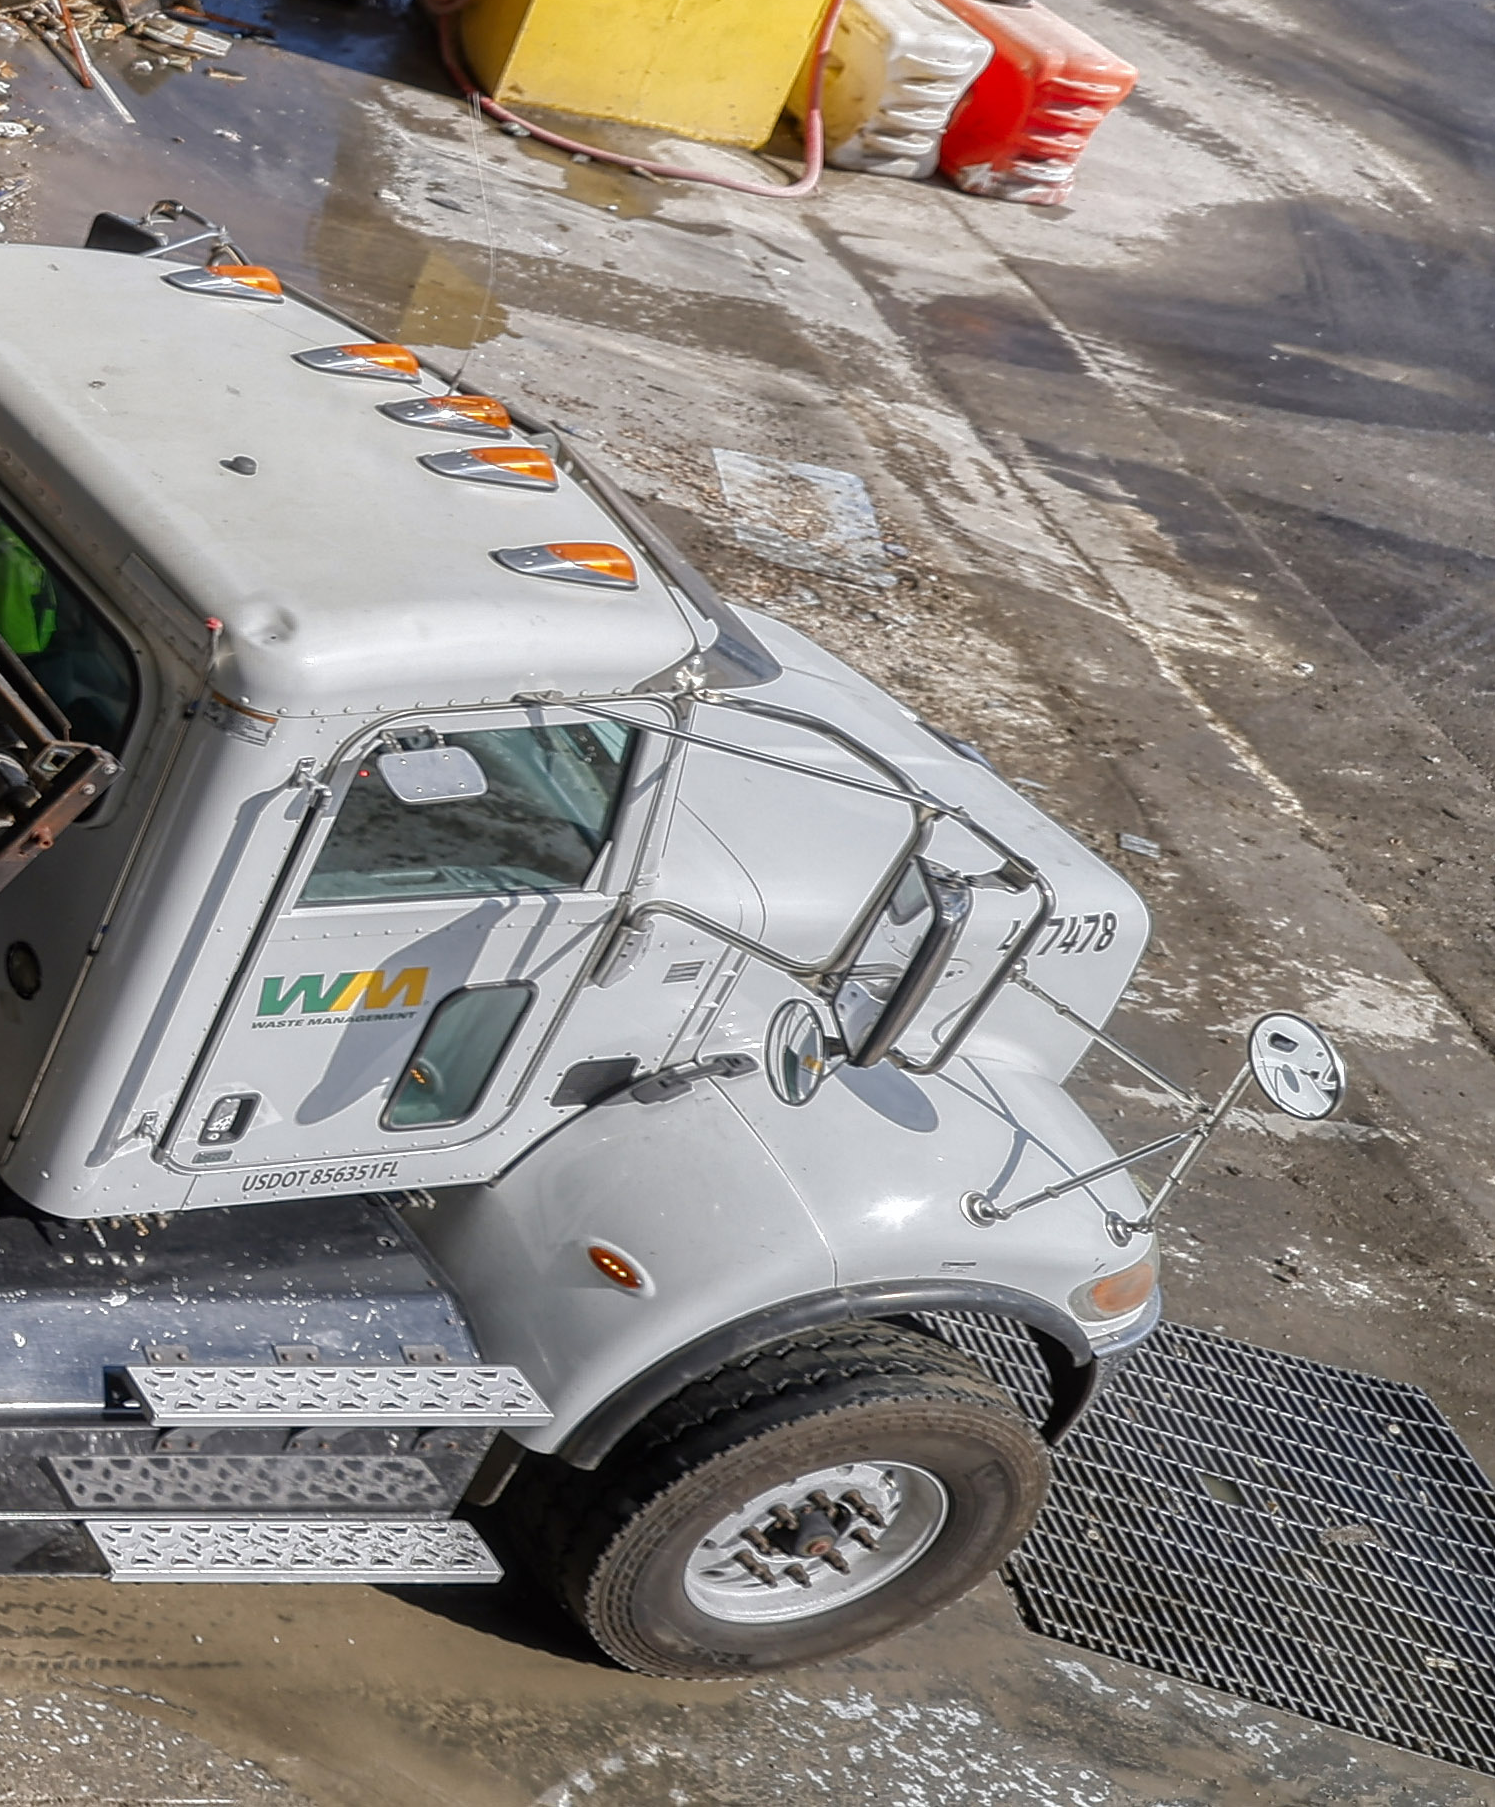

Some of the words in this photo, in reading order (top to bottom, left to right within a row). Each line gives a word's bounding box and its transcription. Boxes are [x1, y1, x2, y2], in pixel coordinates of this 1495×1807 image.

[996, 911, 1117, 956] 47478
[256, 967, 430, 1017] WM
[251, 1018, 304, 1029] WASTE
[307, 1012, 417, 1026] MANAGEMENT
[241, 1169, 311, 1192] USDOT
[309, 1161, 399, 1186] 856351FL
